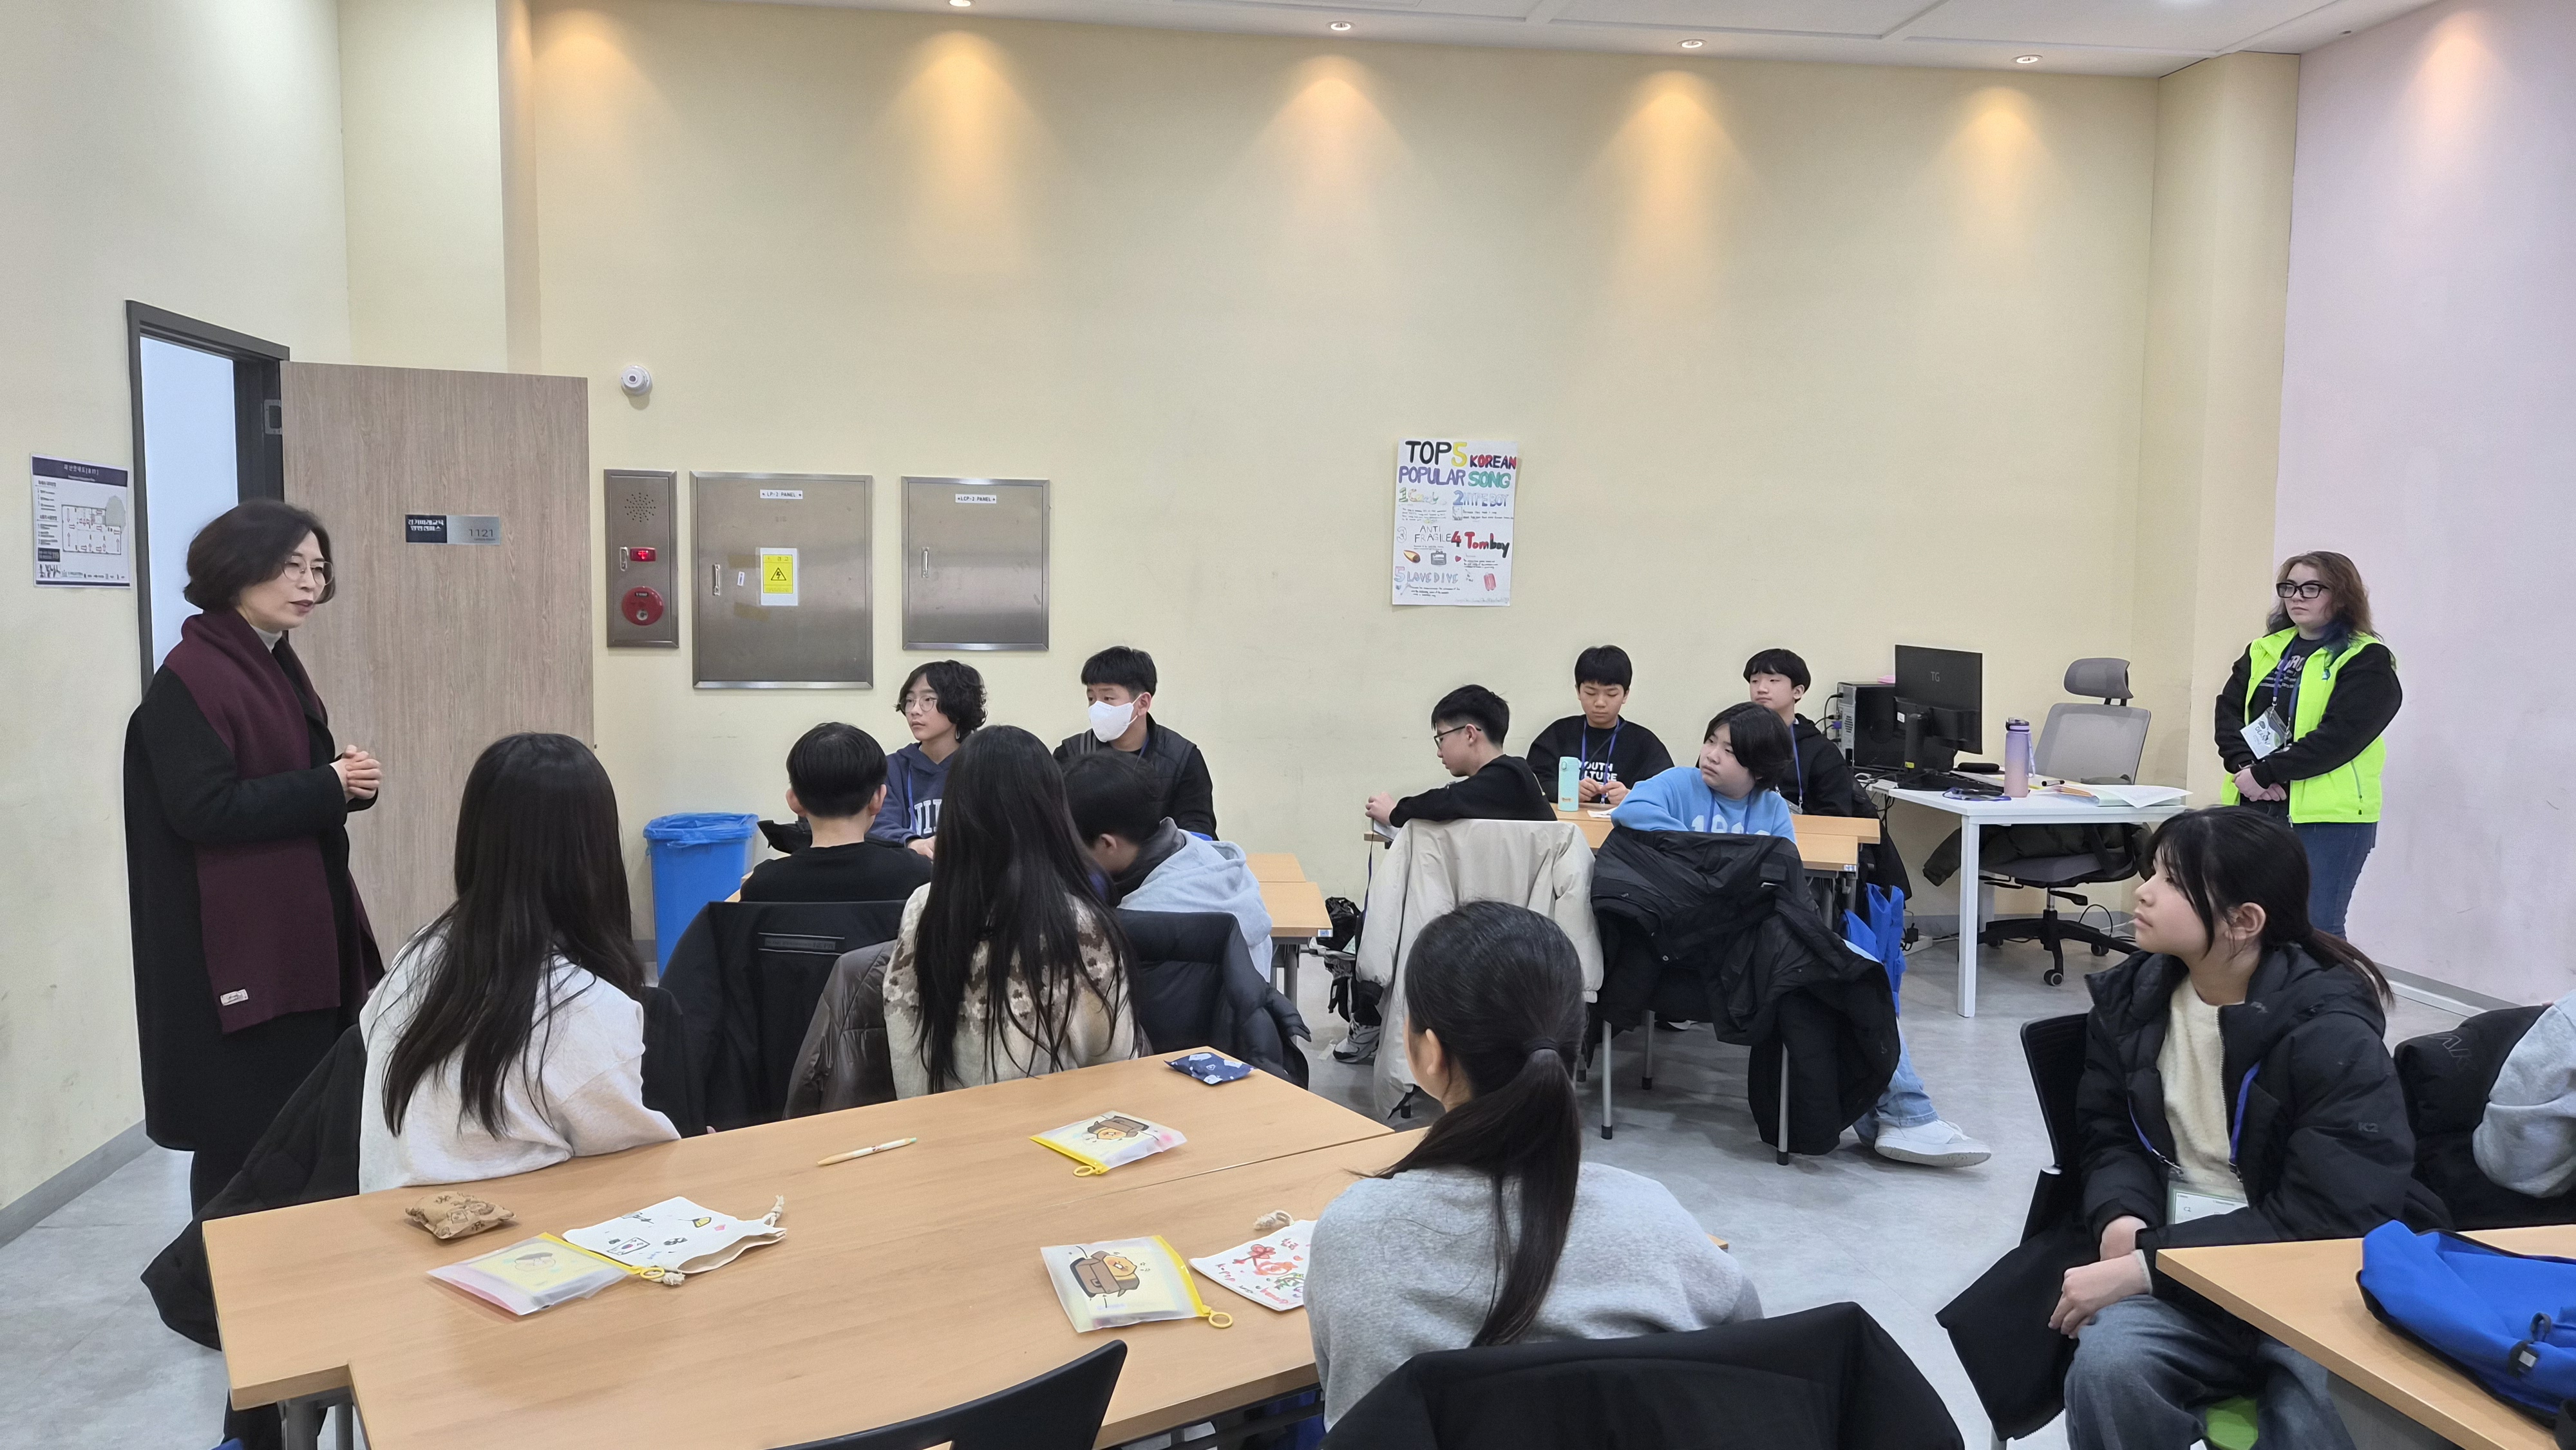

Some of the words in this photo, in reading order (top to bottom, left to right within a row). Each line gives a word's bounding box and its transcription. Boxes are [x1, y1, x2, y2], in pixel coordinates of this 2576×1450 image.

[1470, 454, 1517, 469] KOREAN
[1398, 466, 1466, 486] POPULAR
[1468, 471, 1511, 488] SONG
[1491, 493, 1509, 507] BOY
[468, 529, 494, 538] 1121
[1419, 525, 1441, 533] ANTI
[1414, 533, 1452, 543] FRAGILE
[1451, 531, 1462, 547] 4
[1464, 531, 1510, 558] Tomboy
[1931, 671, 1940, 682] TG
